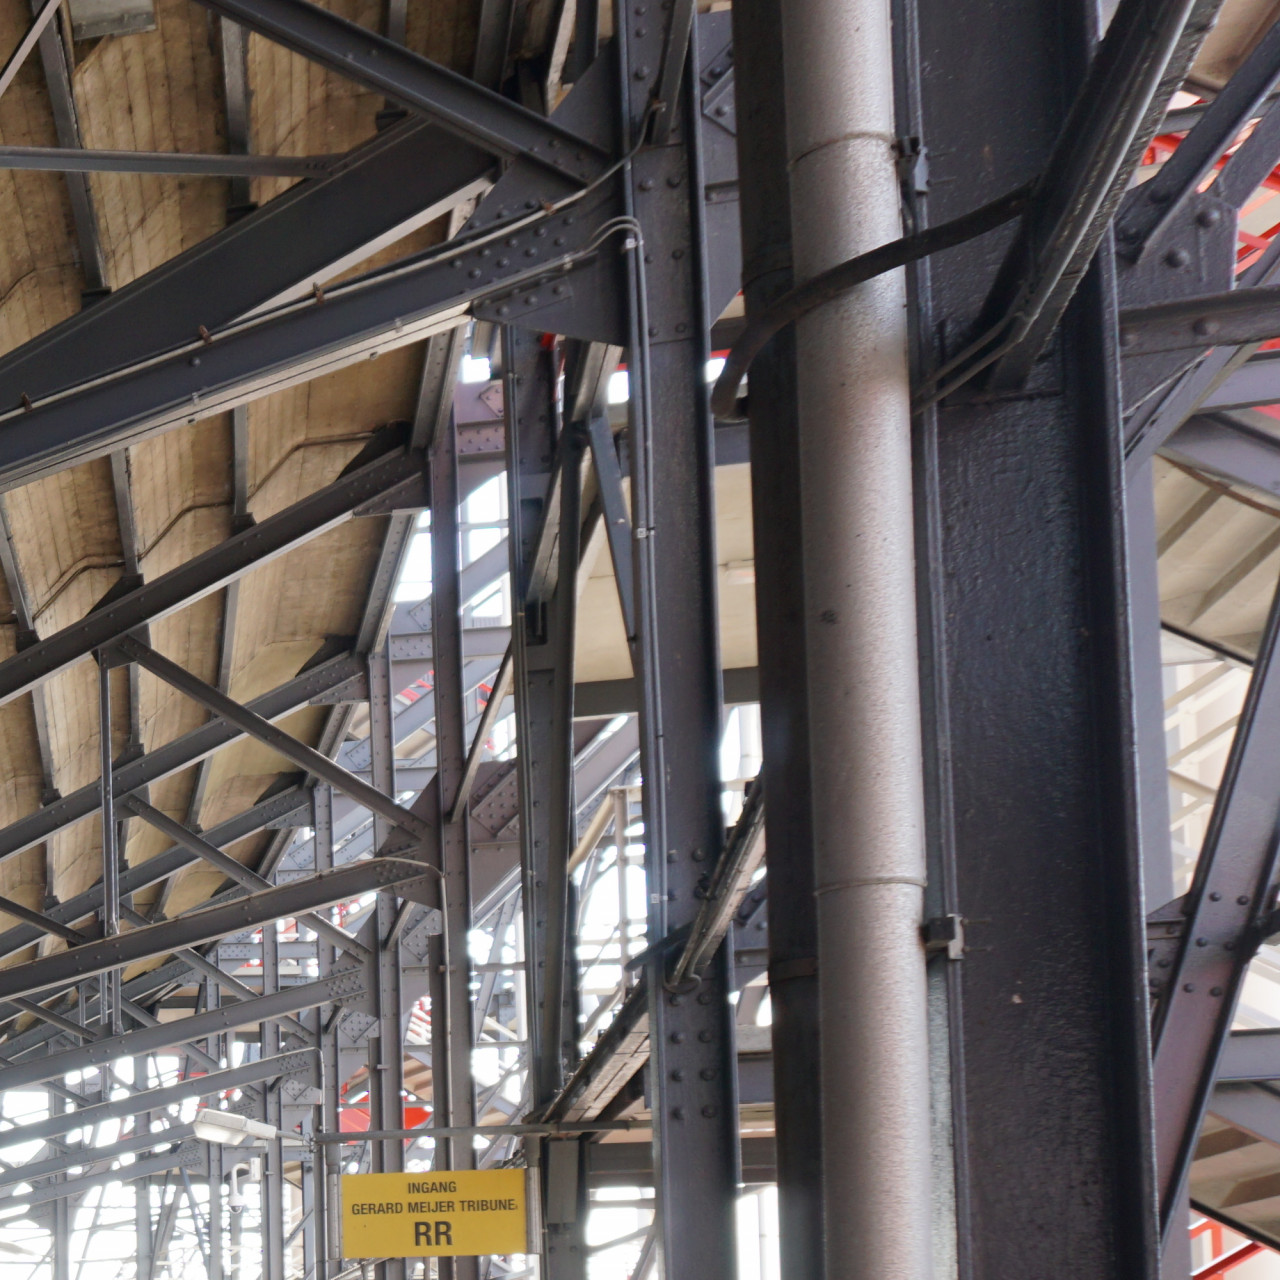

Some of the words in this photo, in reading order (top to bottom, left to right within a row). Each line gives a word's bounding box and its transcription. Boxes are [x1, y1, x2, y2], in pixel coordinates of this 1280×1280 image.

[407, 1181, 457, 1194] INGANG
[351, 1202, 404, 1216] GERARD
[407, 1200, 456, 1214] MEIJER
[459, 1199, 516, 1213] TRIBUNE
[414, 1221, 453, 1247] RR
